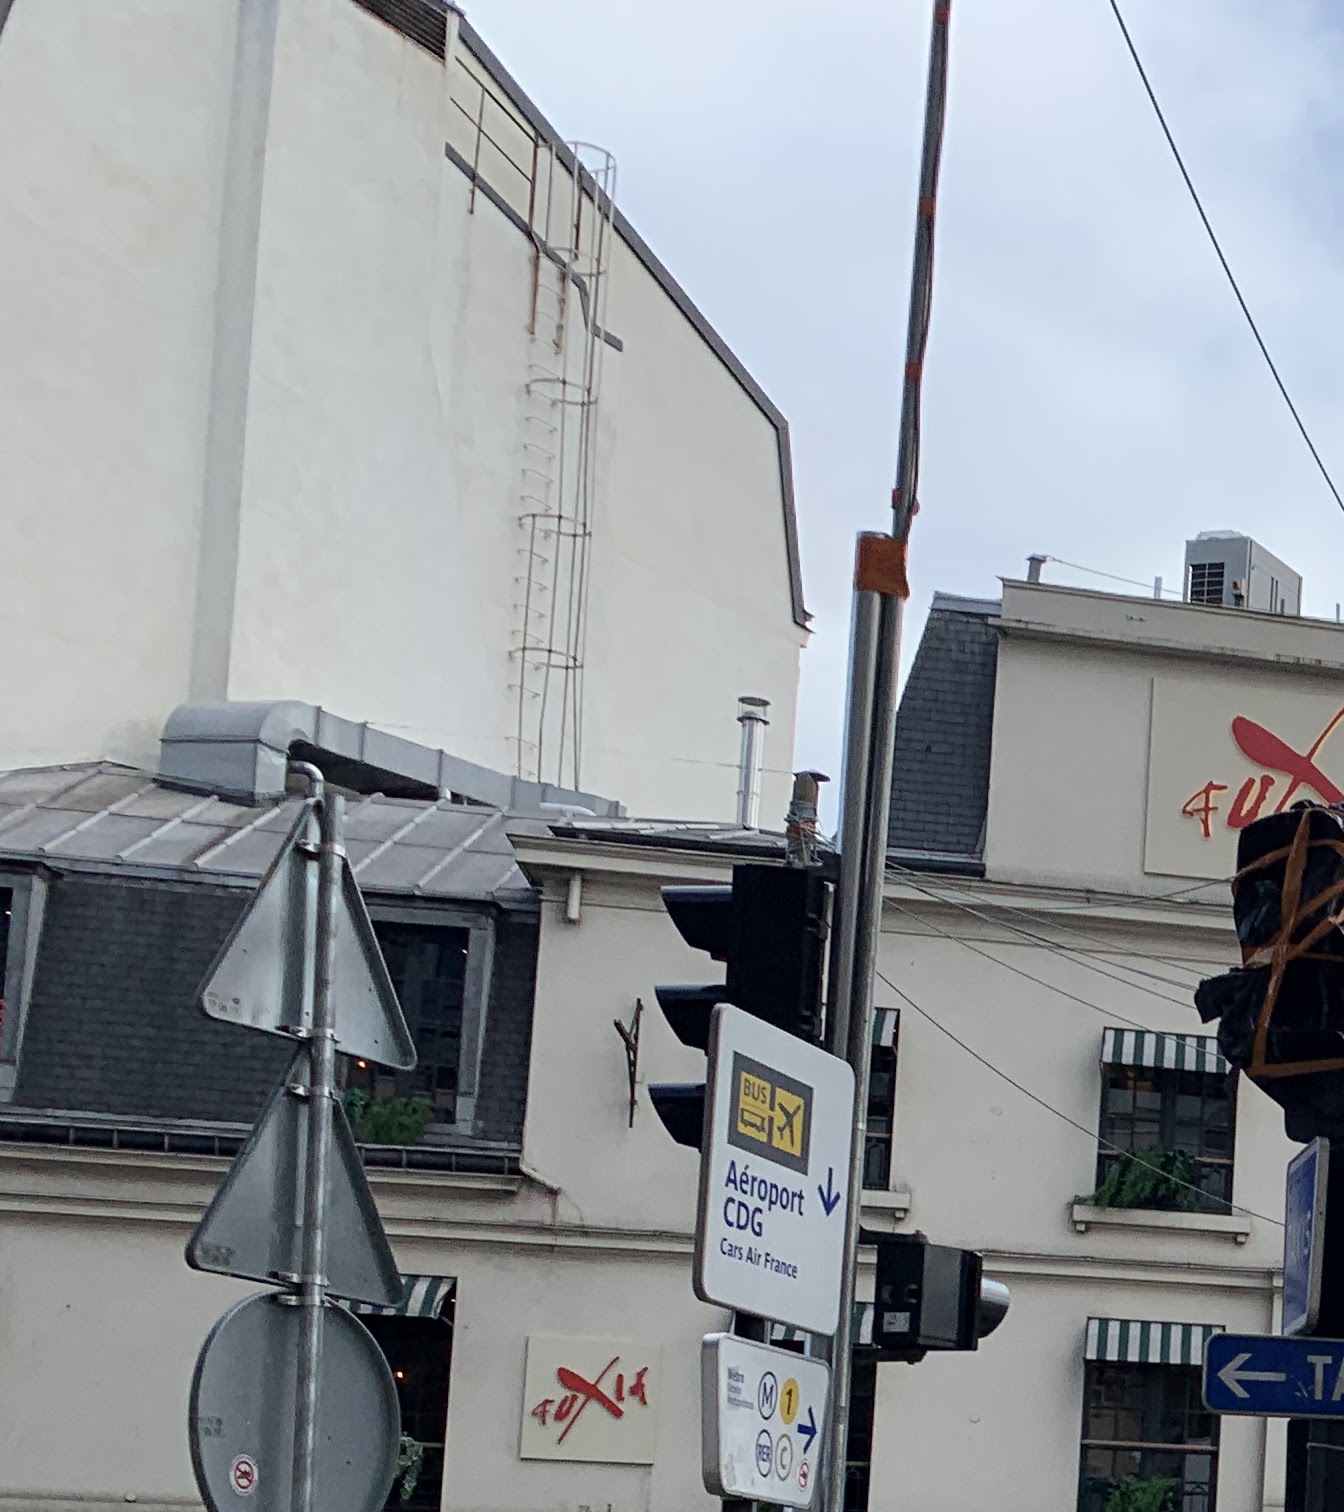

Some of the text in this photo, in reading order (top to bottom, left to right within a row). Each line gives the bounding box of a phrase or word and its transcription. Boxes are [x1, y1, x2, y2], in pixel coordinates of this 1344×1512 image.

[743, 1077, 768, 1105] BUS
[725, 1160, 804, 1216] Aéroport
[723, 1197, 763, 1237] CDG
[720, 1237, 797, 1279] Cars Air France
